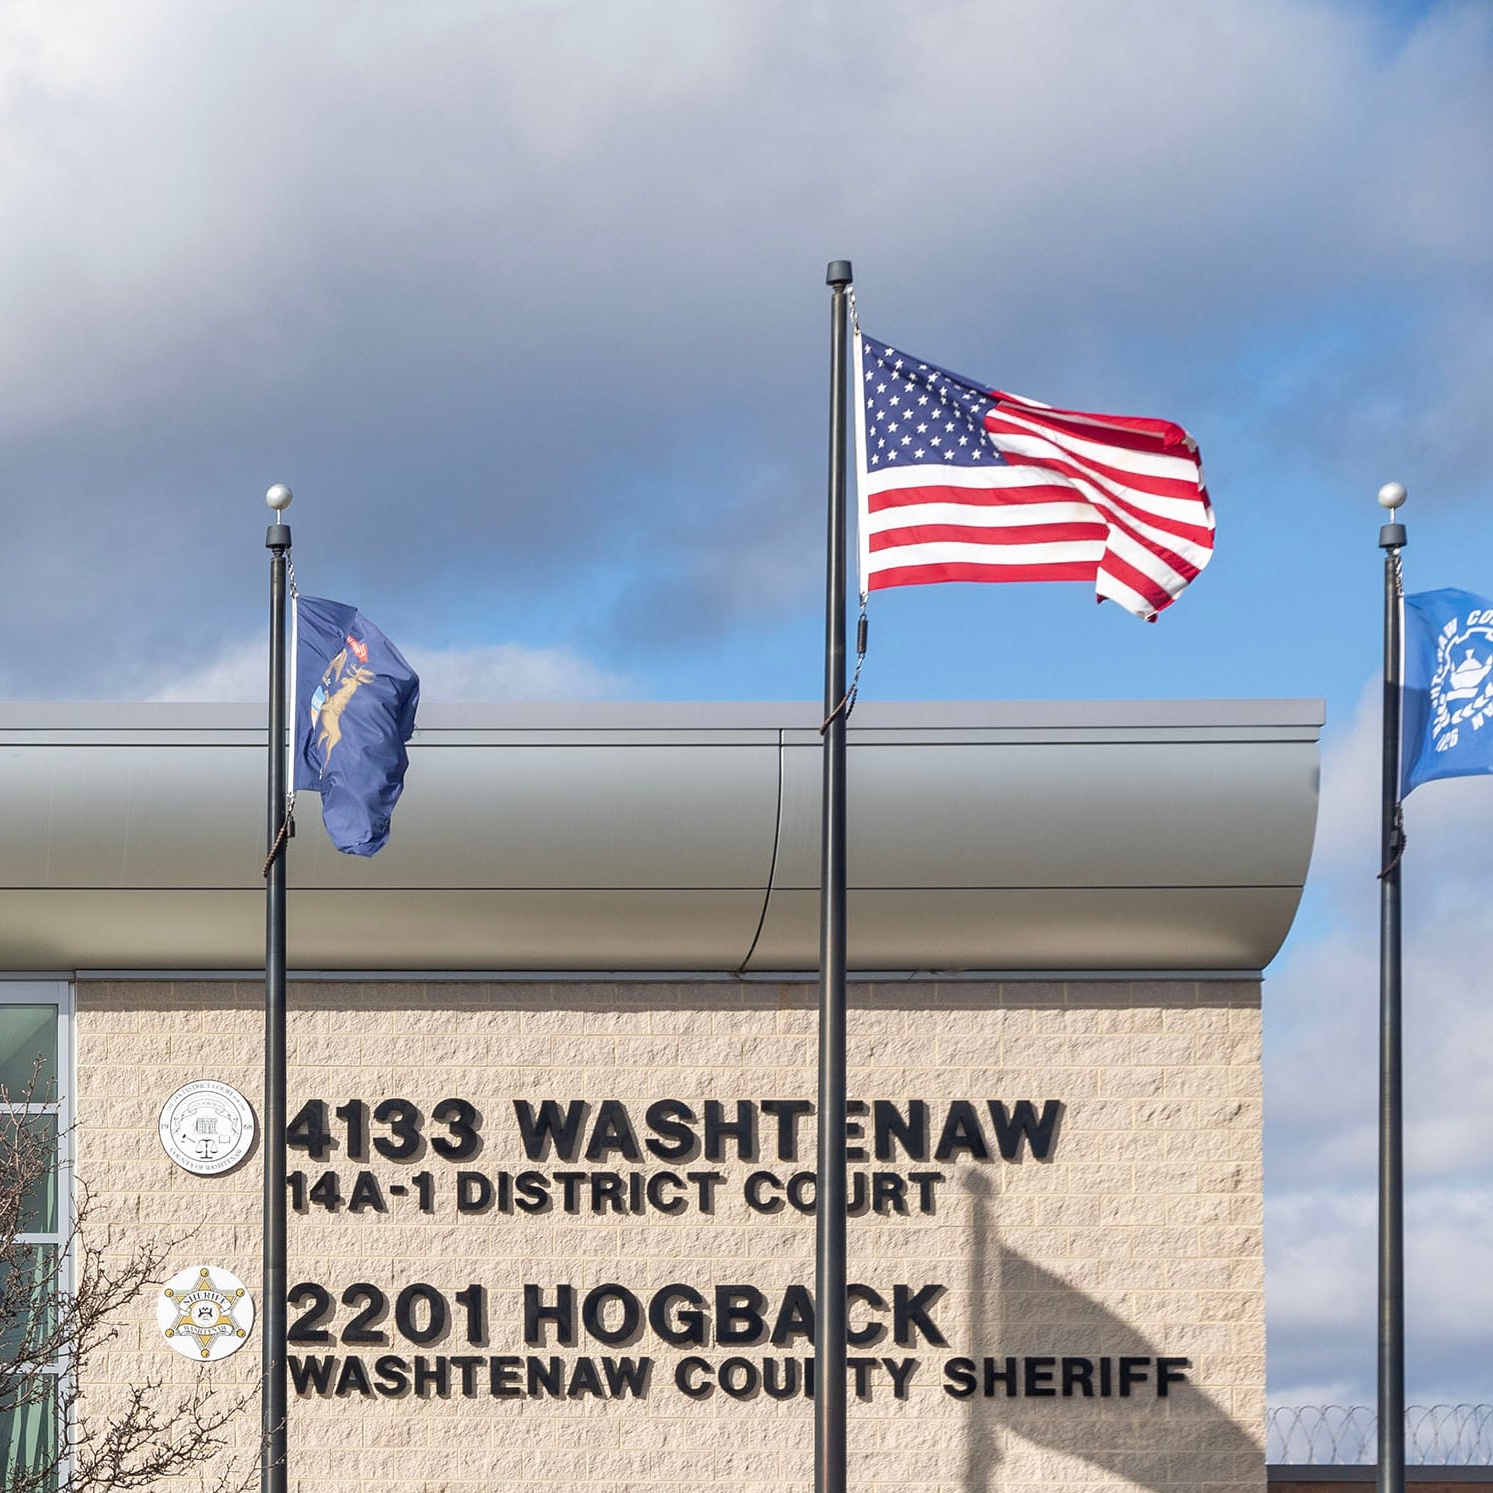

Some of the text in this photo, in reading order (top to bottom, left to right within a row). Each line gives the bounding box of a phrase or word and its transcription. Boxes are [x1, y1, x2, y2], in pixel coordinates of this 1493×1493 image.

[1467, 610, 1493, 626] CO
[286, 1098, 478, 1159] 4133
[287, 1170, 943, 1213] 14A-1 DISTRICT COURT
[183, 1292, 228, 1306] SHERIFF
[287, 1282, 948, 1346] 2201 HOGBACK
[287, 1354, 1191, 1400] WASHTENAW COUTY SHERIFF
